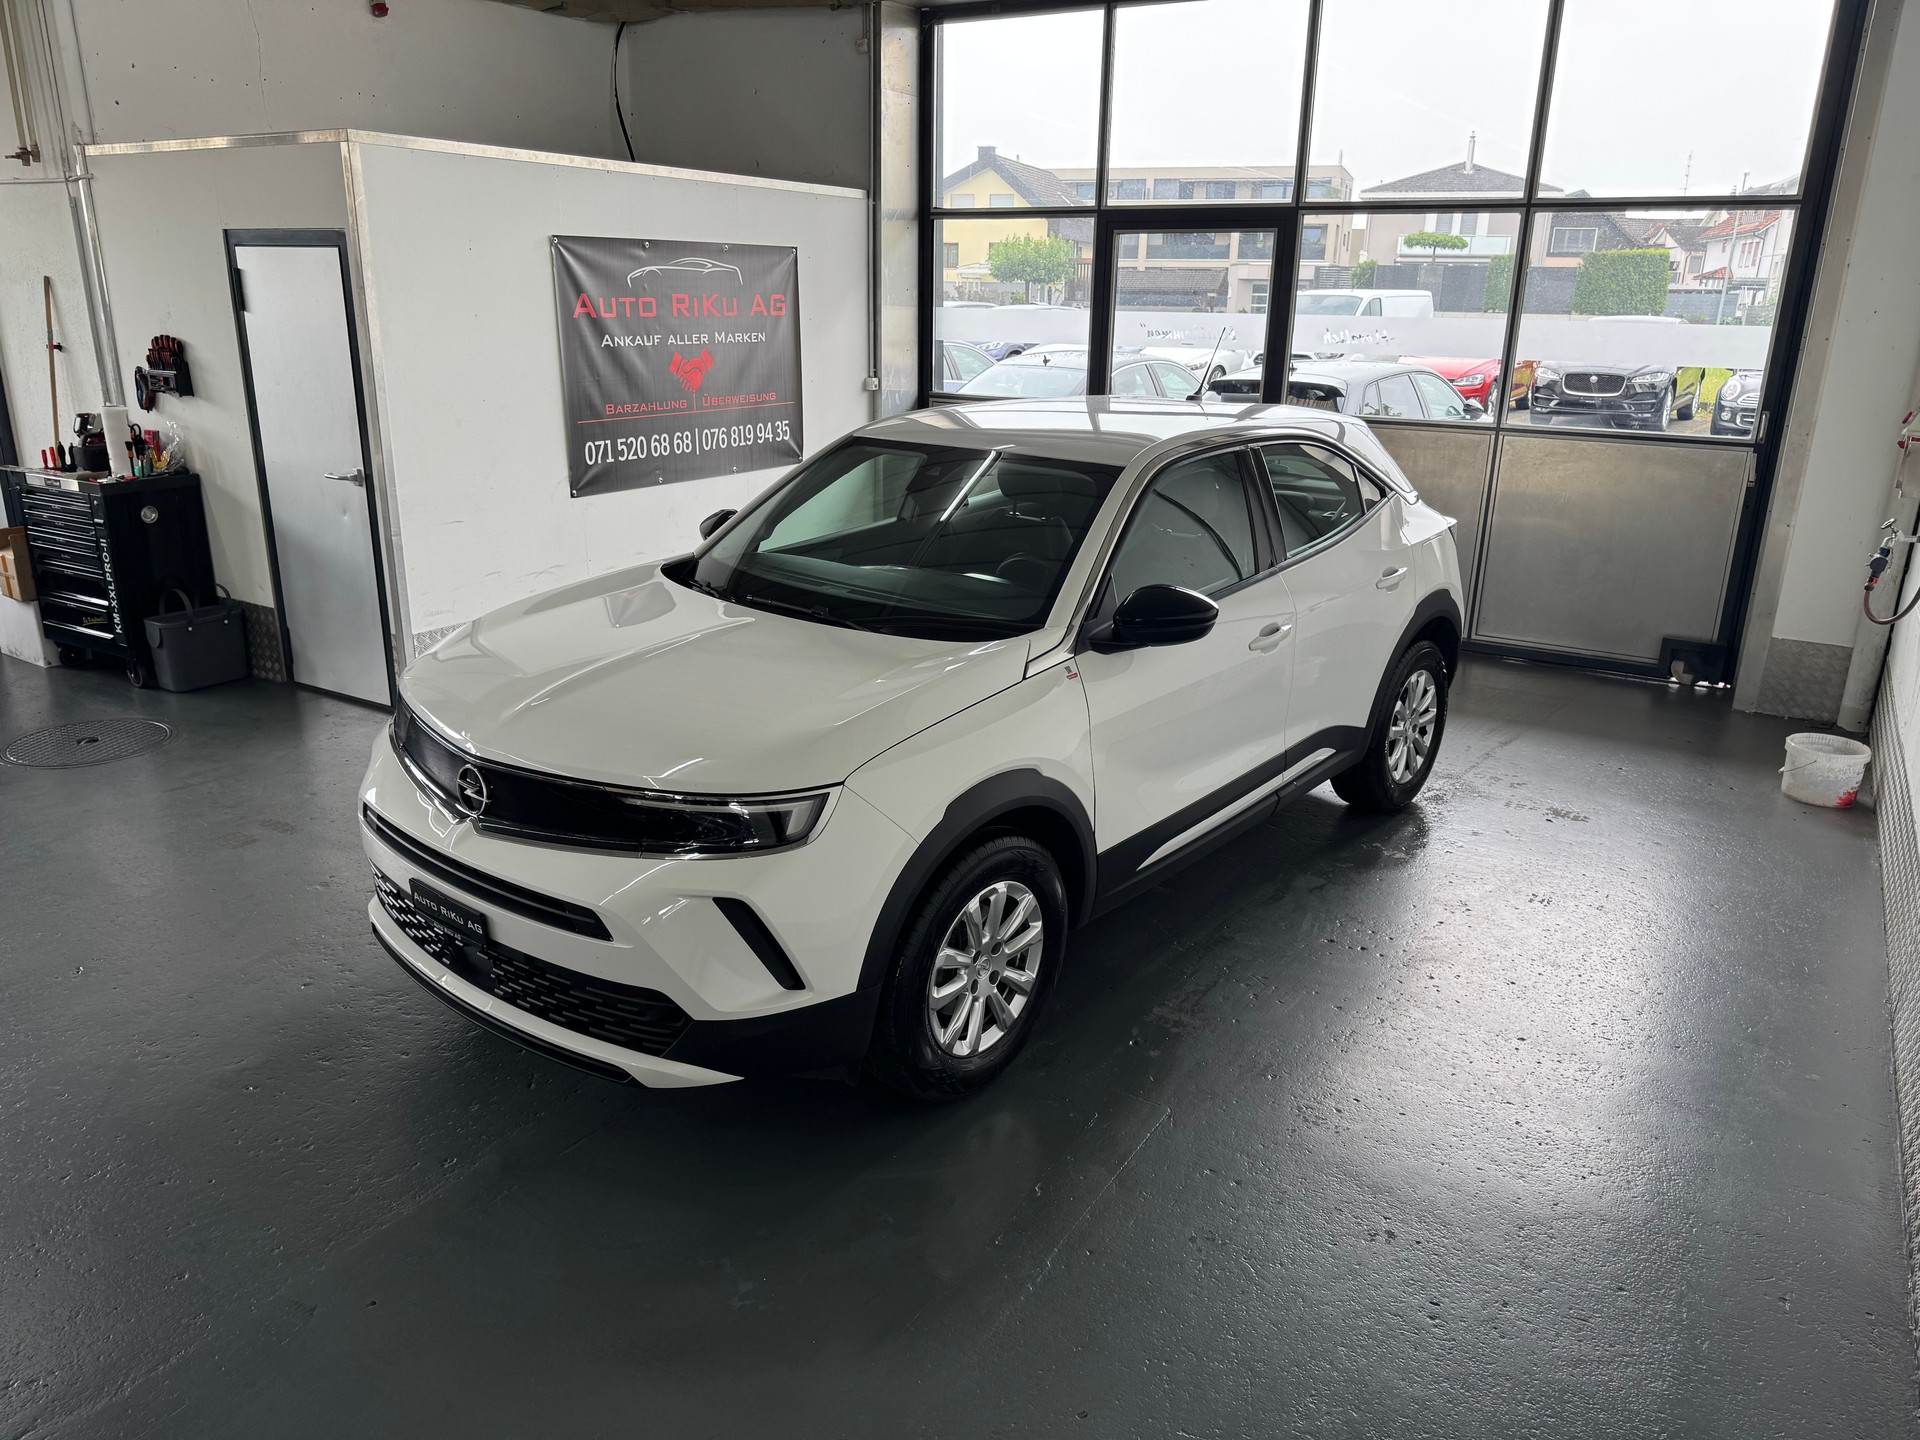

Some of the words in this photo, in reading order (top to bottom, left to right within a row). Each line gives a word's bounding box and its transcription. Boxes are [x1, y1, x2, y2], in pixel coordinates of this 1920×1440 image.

[573, 293, 657, 318] AUTO
[750, 293, 786, 317] AG
[601, 334, 662, 348] ANKAUF
[667, 334, 709, 346] ALLER
[715, 331, 766, 344] MARKEN
[605, 399, 688, 415] BARZAHLUNG
[702, 392, 776, 407] ÜBERWEISUNG
[584, 440, 615, 466] 071
[617, 435, 647, 462] 520
[651, 433, 670, 458] 68
[673, 431, 692, 455] 68
[702, 427, 728, 451] 076
[731, 424, 754, 448] 819
[756, 422, 773, 444] 94
[775, 420, 790, 442] 35
[467, 920, 483, 935] AG
